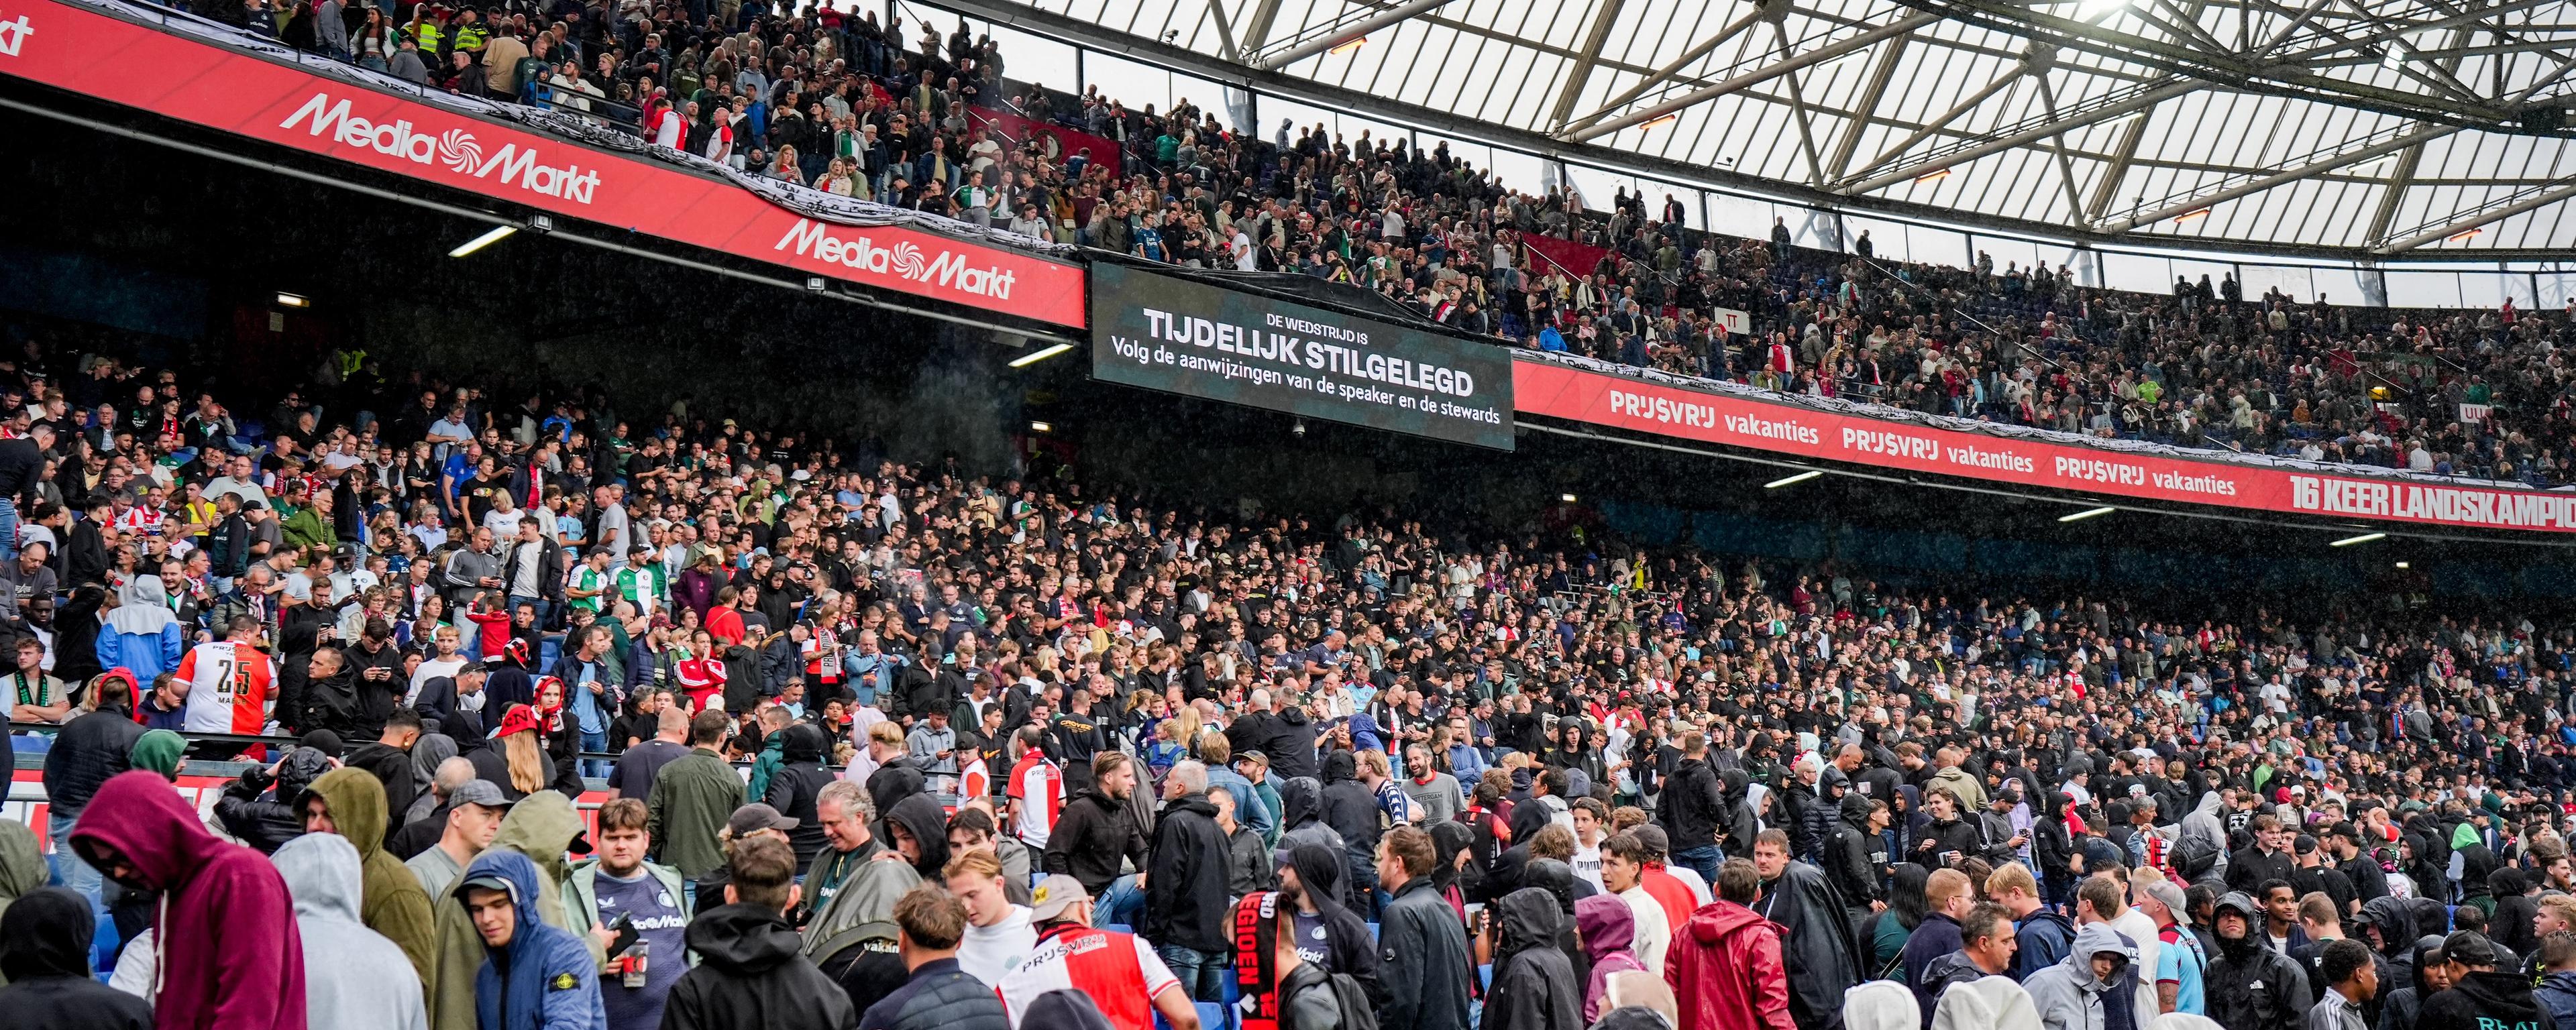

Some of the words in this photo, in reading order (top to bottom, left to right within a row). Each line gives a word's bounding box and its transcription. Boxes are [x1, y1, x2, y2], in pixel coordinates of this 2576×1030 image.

[279, 93, 437, 164] Media
[474, 144, 600, 204] Markt
[775, 219, 890, 274] Media
[918, 251, 1015, 300] Markt
[1267, 312, 1283, 328] DE
[1285, 317, 1355, 342] WEDSTRIJD
[1357, 332, 1368, 345] IS
[1143, 308, 1301, 365] TIJDELIJK
[1305, 341, 1474, 397] STILGELEGD
[1111, 335, 1149, 365] Volg
[1155, 345, 1175, 365] de
[1179, 354, 1281, 386] aanwijzingen
[1286, 374, 1313, 390] van
[1317, 375, 1335, 394] de
[1339, 384, 1395, 405] speaker
[1399, 395, 1416, 410] en
[1419, 394, 1438, 413] de
[1441, 401, 1501, 424] stewards
[1725, 414, 1819, 445] vakanties
[1947, 446, 2034, 473] vakanties
[2152, 471, 2236, 496] vakanties
[2290, 475, 2320, 510] 16
[2323, 479, 2389, 516] KEER
[217, 659, 252, 695] 25
[1578, 861, 1600, 871] PUM
